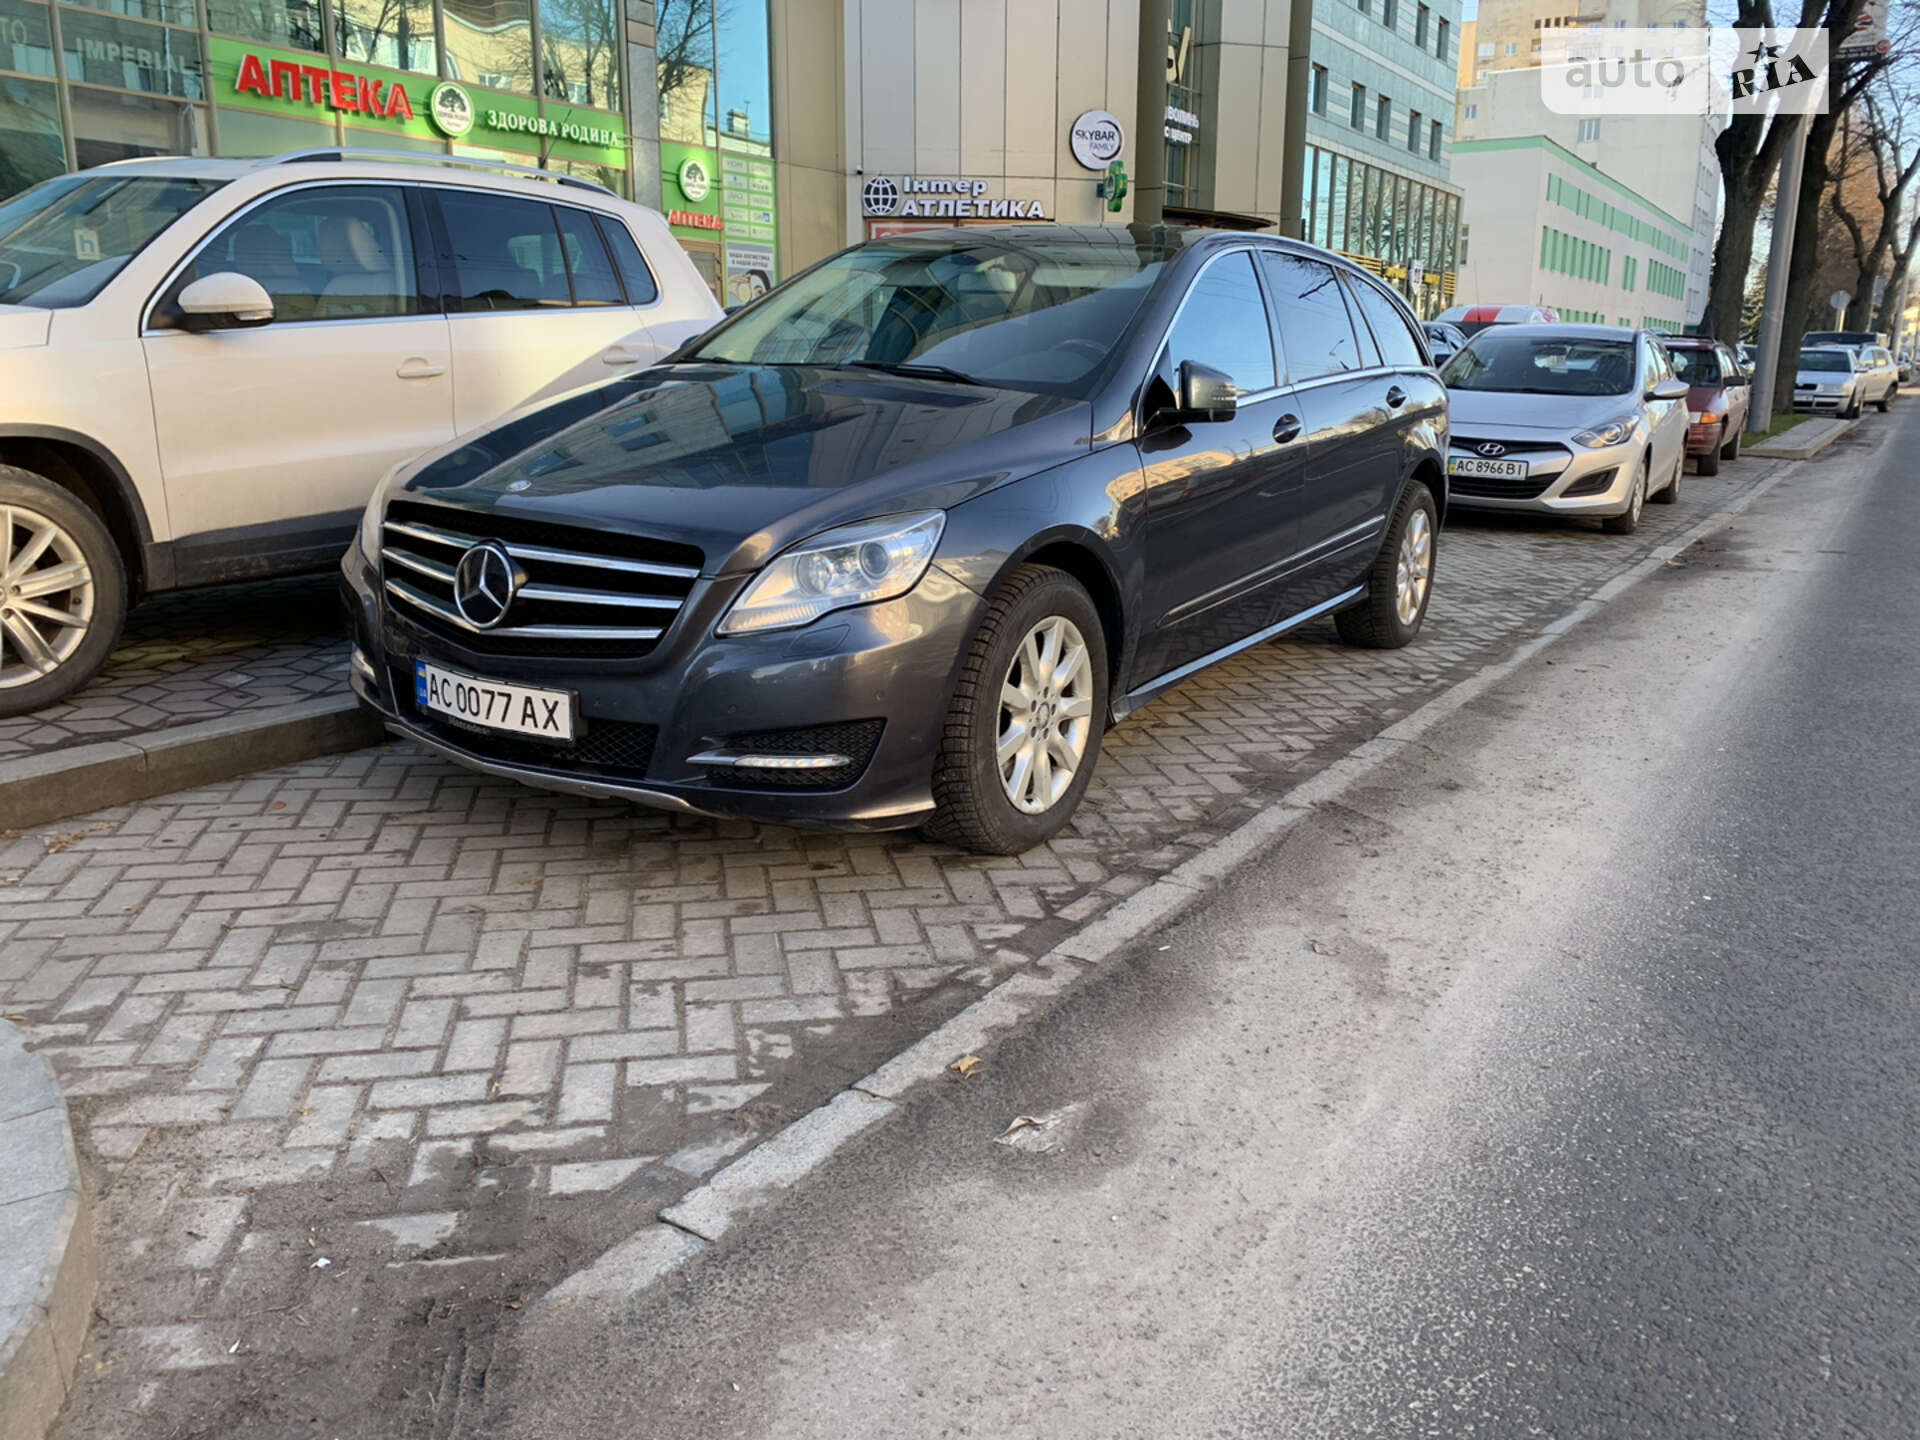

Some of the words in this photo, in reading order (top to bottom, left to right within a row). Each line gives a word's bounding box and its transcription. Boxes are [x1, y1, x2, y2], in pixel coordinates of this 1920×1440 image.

[76, 38, 186, 74] IMPERIAL
[235, 54, 414, 120] АПТЕКА
[487, 109, 558, 137] ЗДОРОВА
[561, 121, 619, 147] РОДИНА
[1075, 129, 1115, 141] SKYBAR
[1089, 142, 1114, 151] FAMILY
[903, 176, 988, 196] Інтер
[900, 199, 1045, 218] АТЛЕТИКА
[669, 209, 723, 230] АПТЕКА
[1456, 460, 1474, 472] AC
[1475, 461, 1504, 474] 8966
[429, 673, 452, 708] AC
[455, 683, 512, 722] 0077
[521, 696, 560, 732] AX
